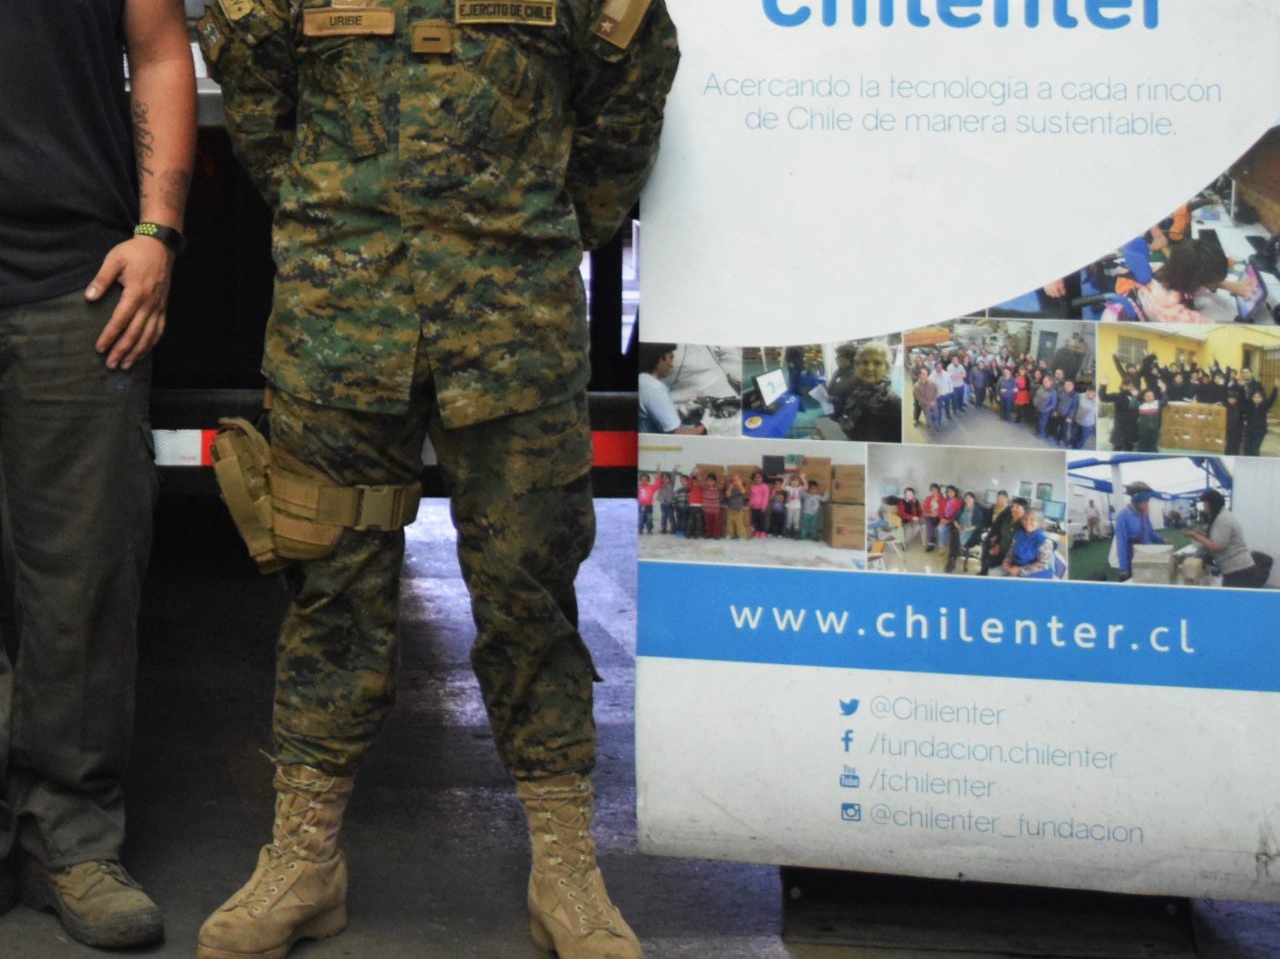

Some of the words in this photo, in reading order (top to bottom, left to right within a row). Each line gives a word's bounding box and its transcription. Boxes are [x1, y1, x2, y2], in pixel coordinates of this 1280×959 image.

[329, 15, 363, 27] URIBE
[459, 2, 509, 18] EJERCITO
[509, 3, 524, 17] DE
[523, 5, 553, 21] CHILE
[702, 72, 851, 98] Acercando
[859, 74, 880, 98] la
[1037, 81, 1053, 100] a
[1060, 76, 1128, 102] cada
[1136, 76, 1223, 103] rincón
[744, 107, 779, 131] de
[786, 105, 854, 131] Chile
[861, 107, 897, 132] de
[905, 113, 1007, 134] manera
[1015, 110, 1178, 137] sustentable.
[729, 604, 1196, 655] www.chilenter.cl
[869, 694, 1006, 727] @Chilenter
[868, 730, 1118, 771] /fundacion.chilenter
[868, 767, 996, 799] /fchilenter
[869, 802, 1145, 844] @chilenter_fundacion
